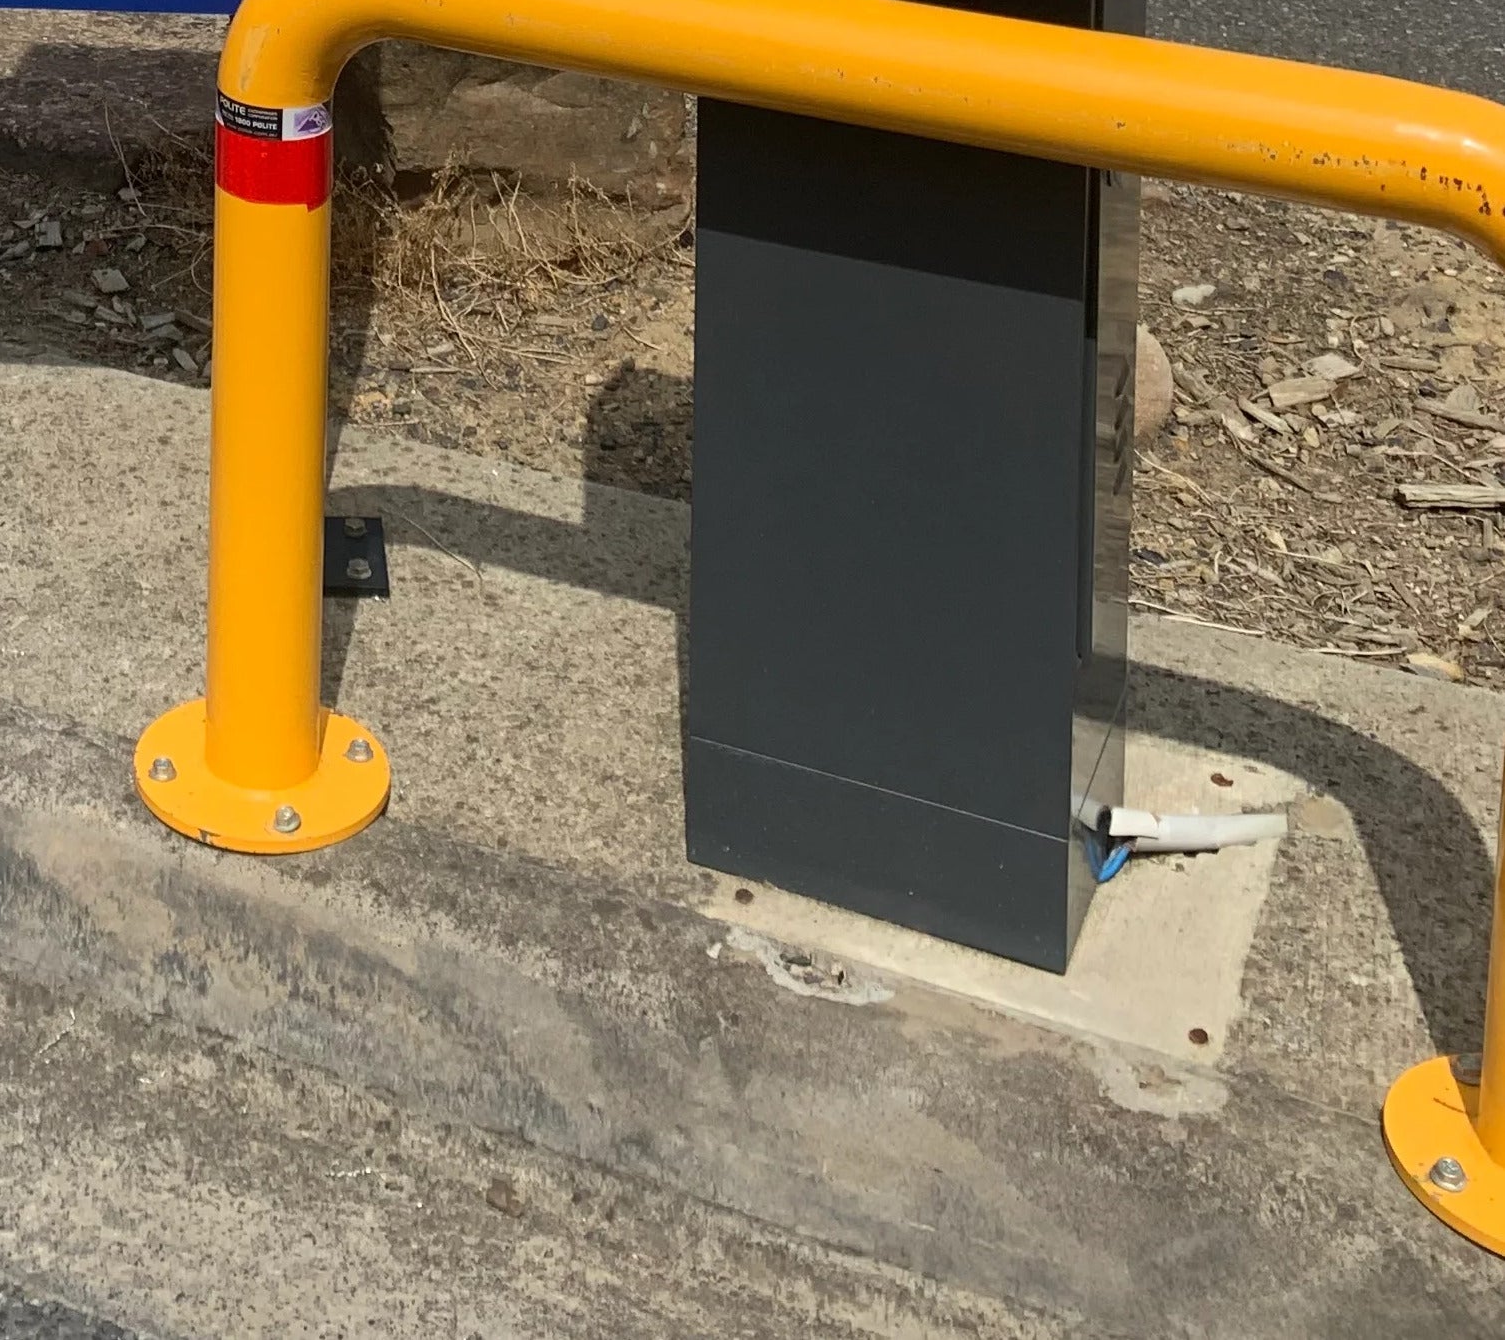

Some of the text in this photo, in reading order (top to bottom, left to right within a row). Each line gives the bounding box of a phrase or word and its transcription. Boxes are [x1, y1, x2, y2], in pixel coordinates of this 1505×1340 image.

[220, 95, 246, 116] POLITE
[235, 116, 278, 130] 1800 POLITE
